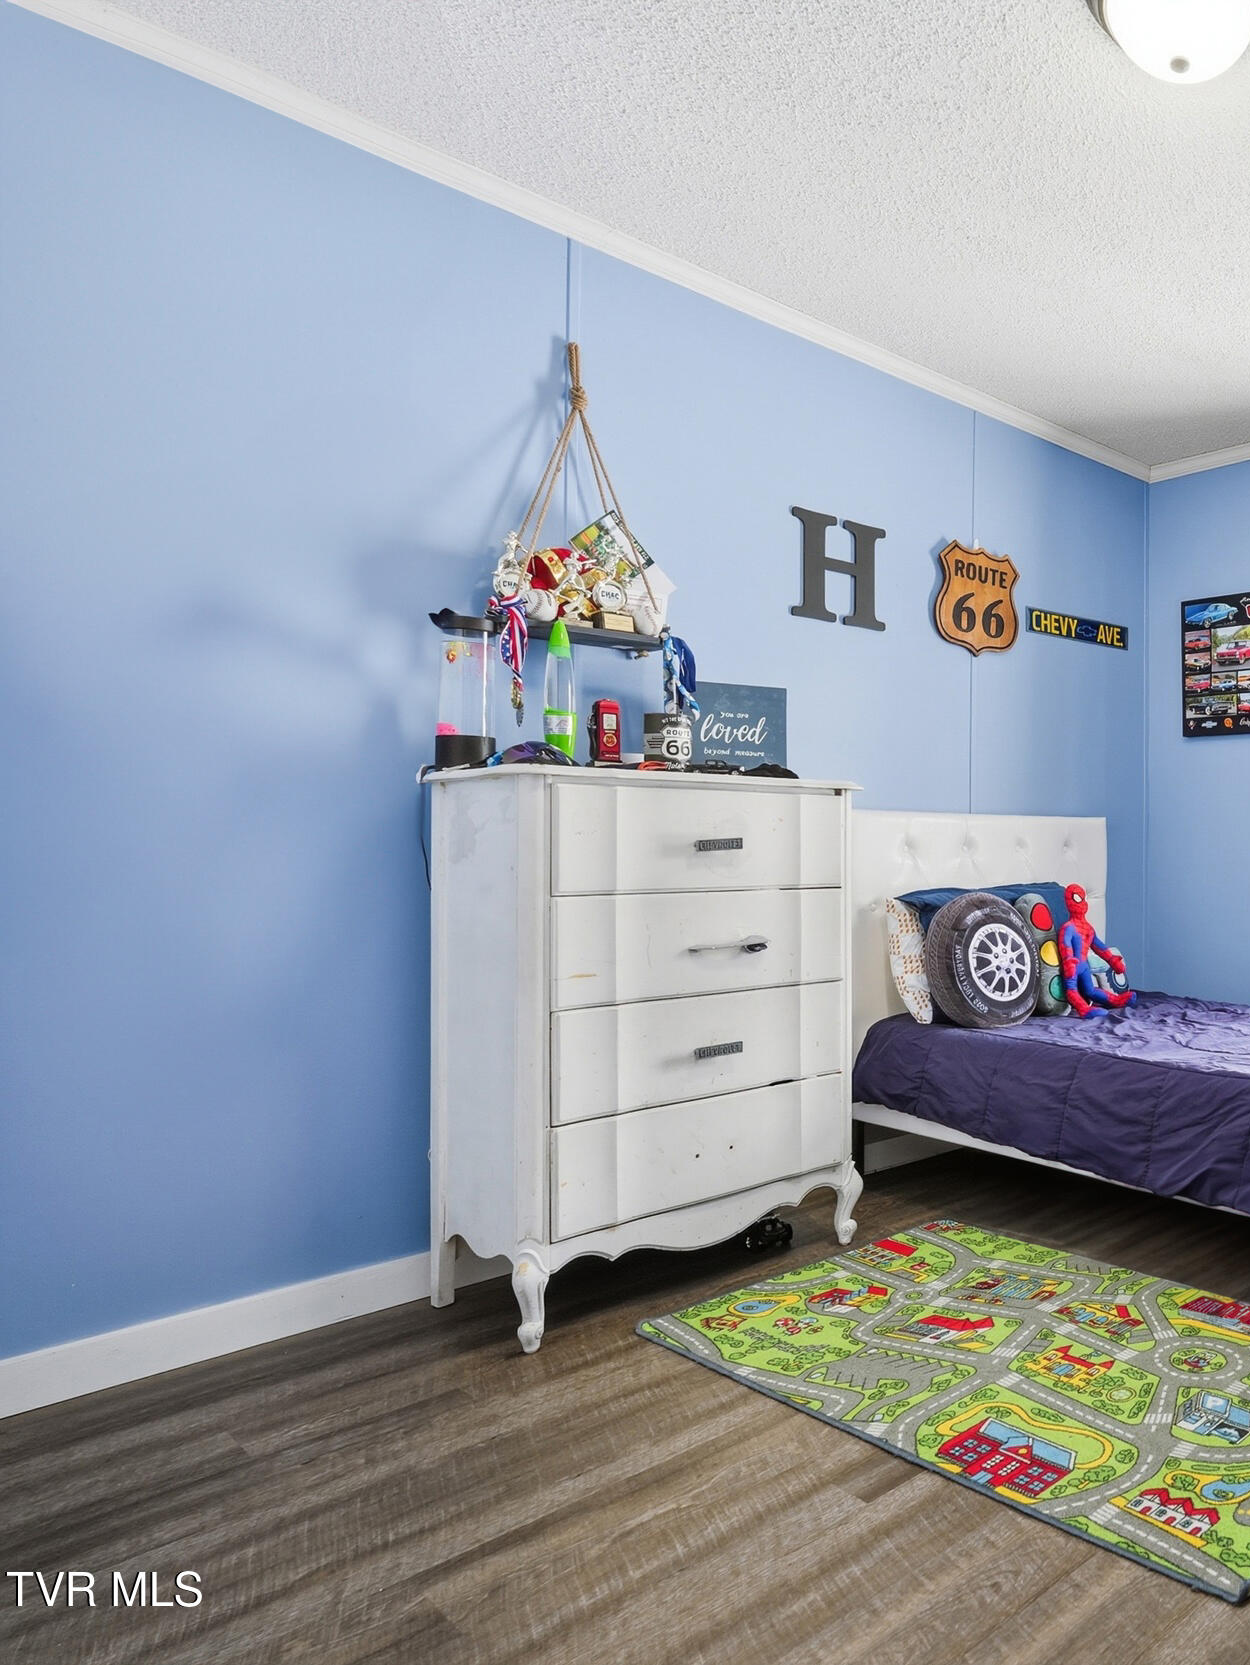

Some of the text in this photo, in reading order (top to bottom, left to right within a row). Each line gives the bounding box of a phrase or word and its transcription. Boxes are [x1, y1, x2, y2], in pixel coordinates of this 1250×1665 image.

[791, 505, 886, 631] H
[954, 558, 1008, 589] ROUTE
[952, 592, 1005, 639] 66
[1031, 610, 1078, 638] CHEVY
[700, 714, 768, 744] loved
[720, 711, 734, 719] you
[666, 740, 690, 757] 66
[703, 747, 731, 757] beyond
